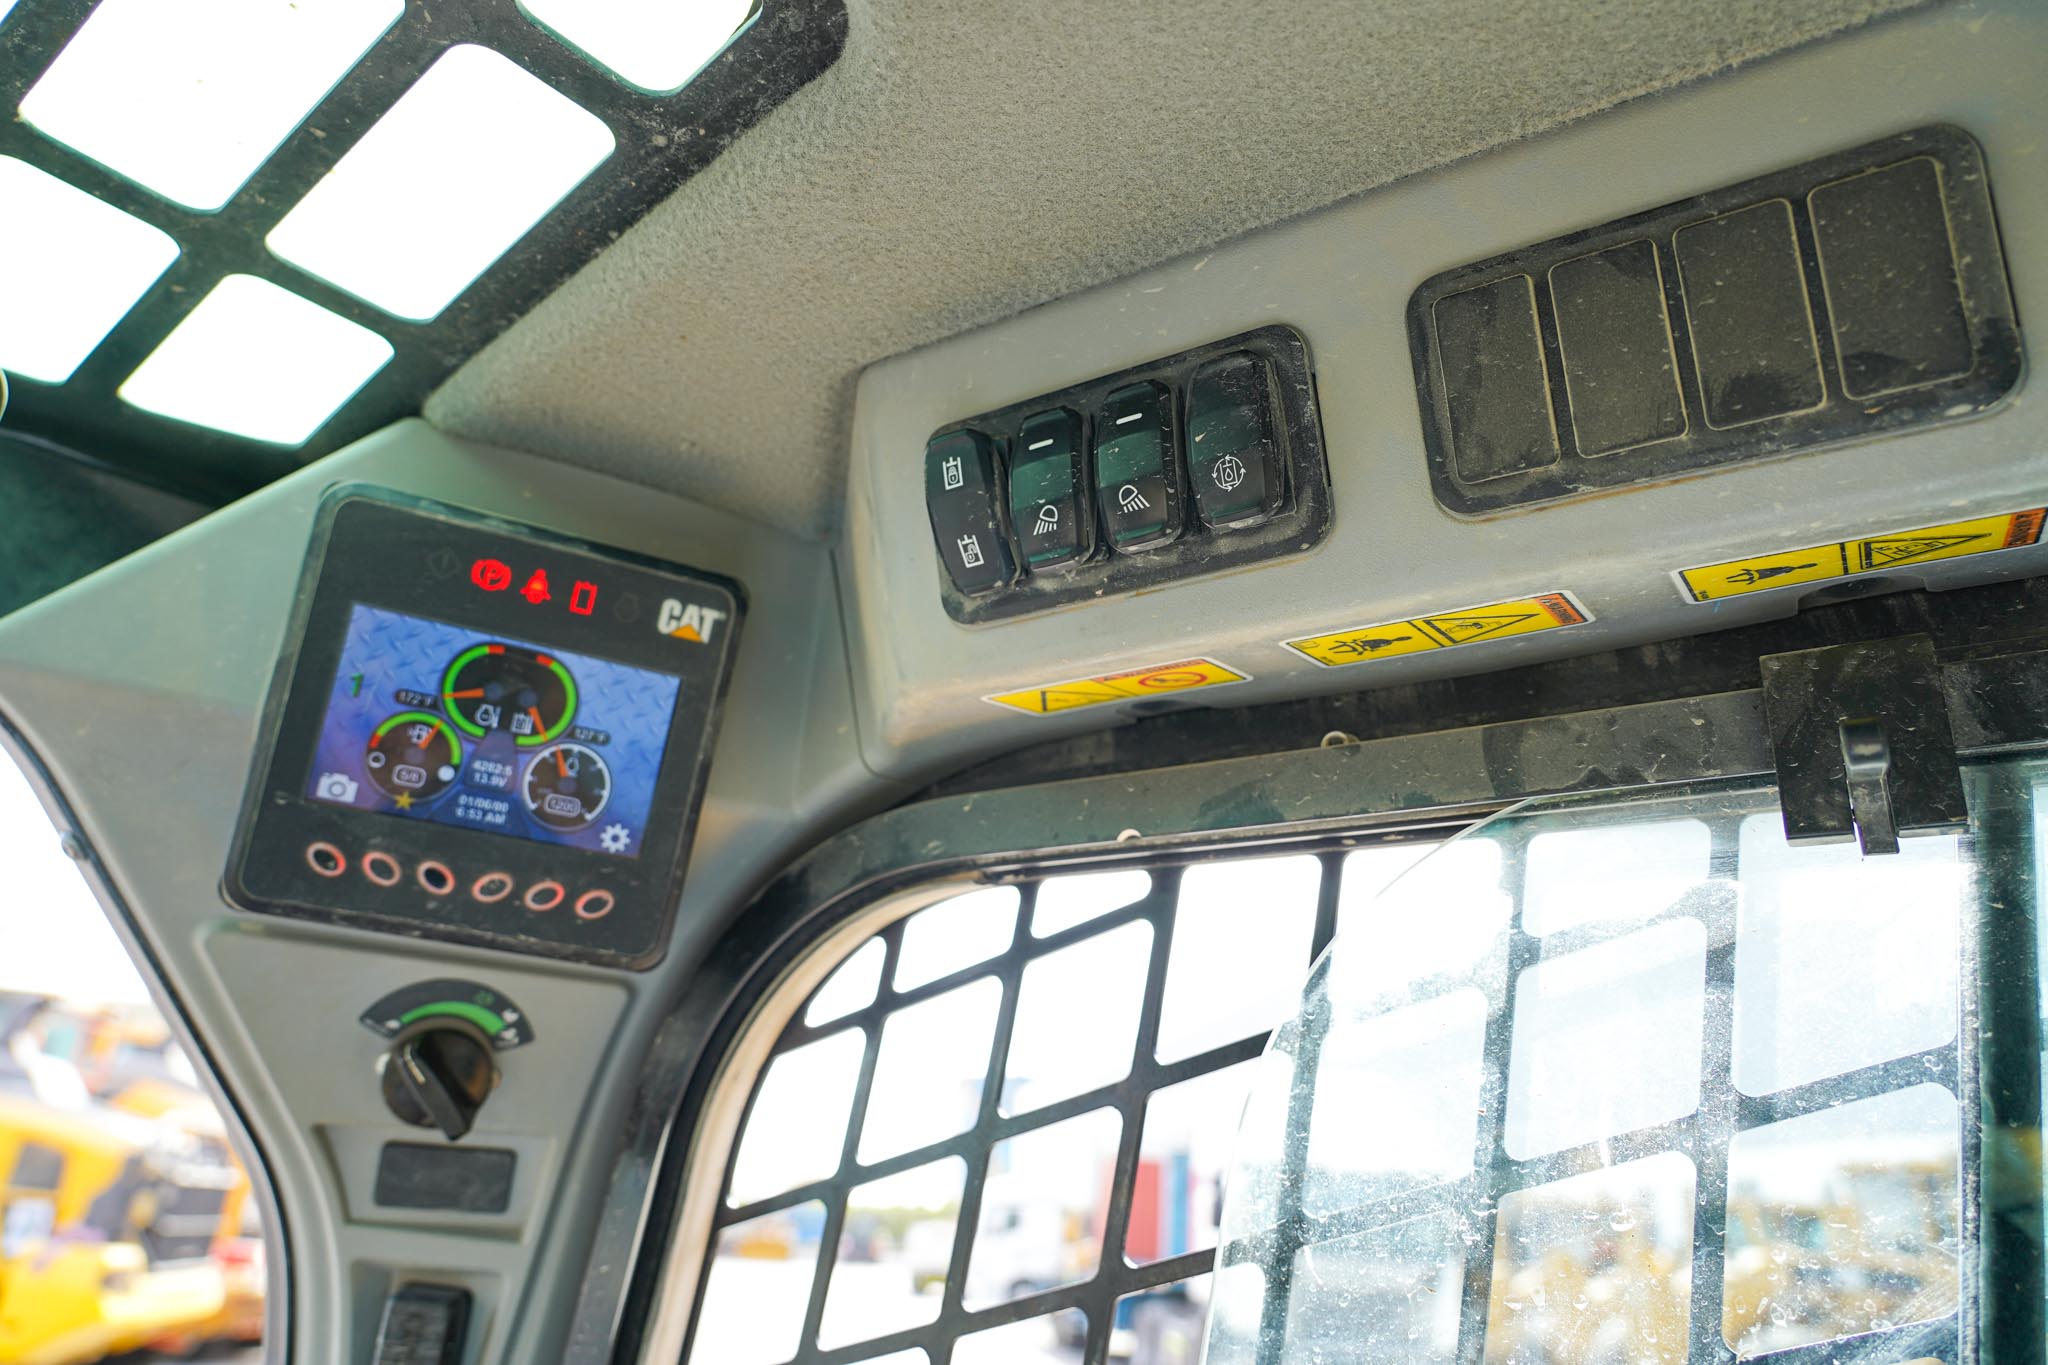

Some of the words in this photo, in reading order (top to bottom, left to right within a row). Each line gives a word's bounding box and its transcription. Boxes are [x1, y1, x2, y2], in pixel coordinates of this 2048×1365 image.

[657, 598, 721, 644] CAT
[350, 673, 363, 697] 1
[484, 812, 506, 824] AM
